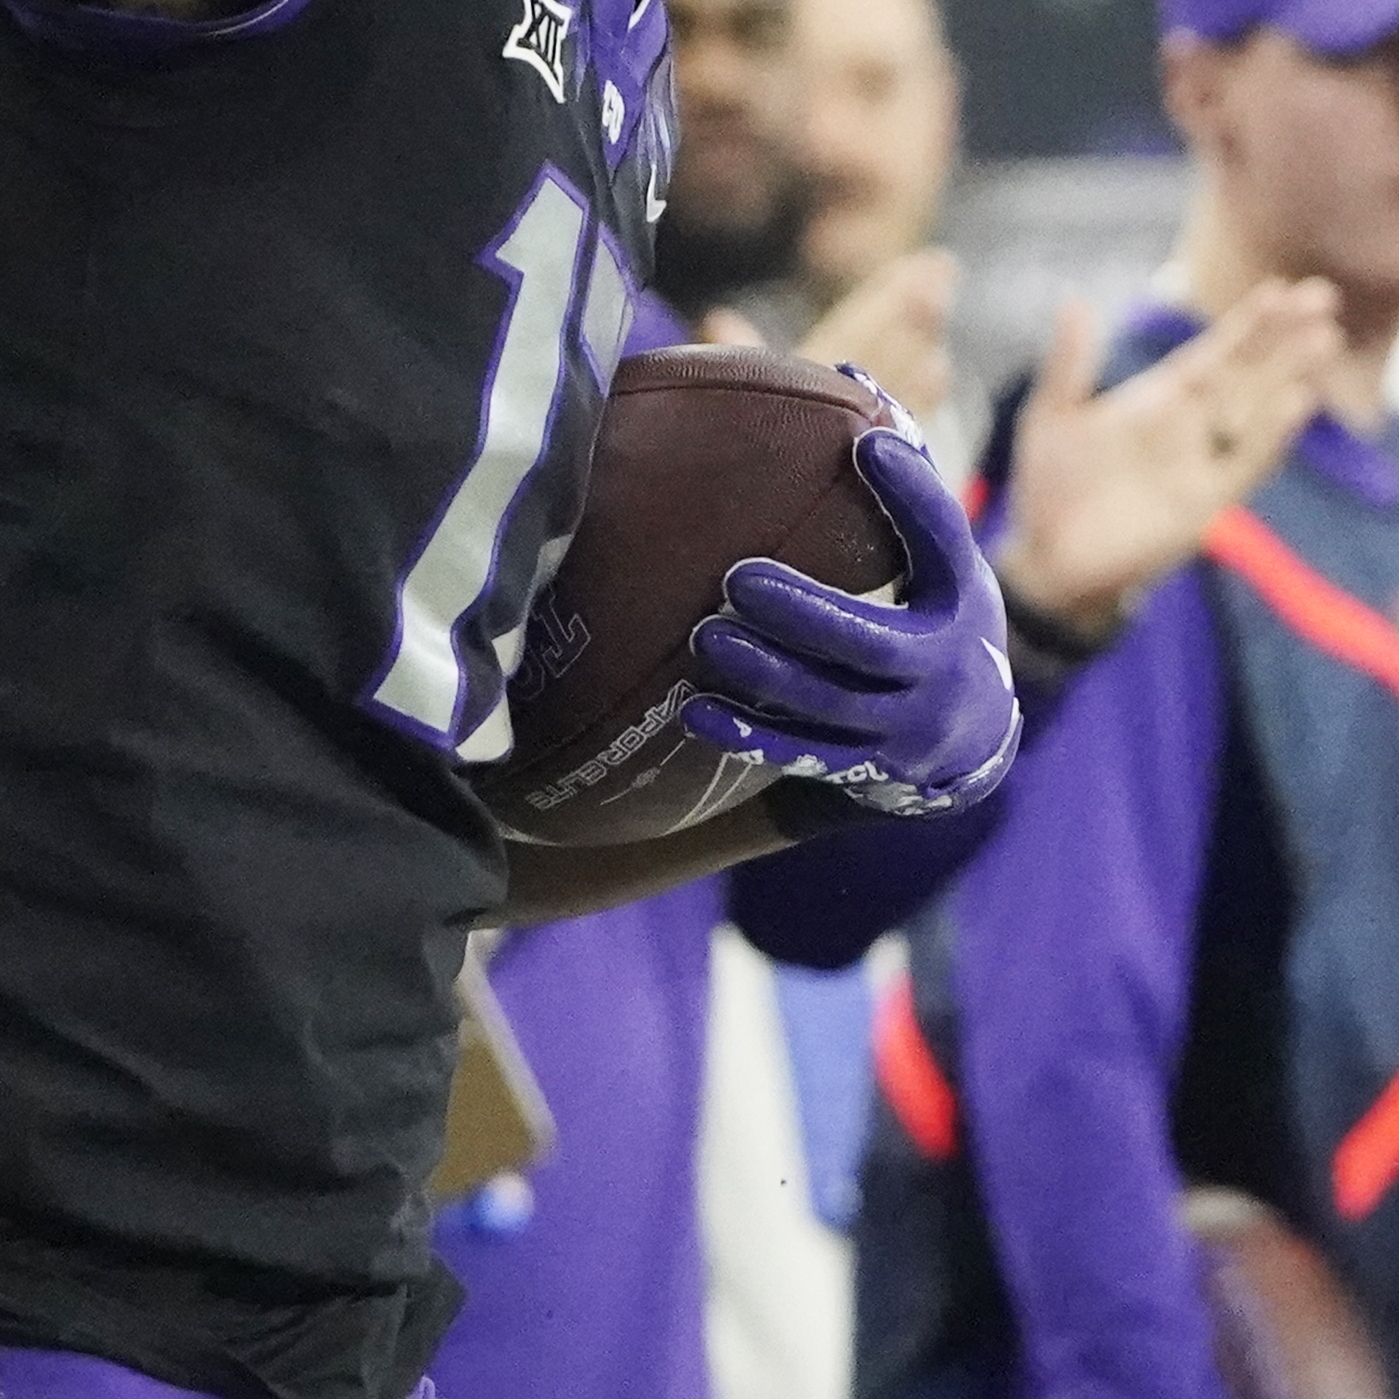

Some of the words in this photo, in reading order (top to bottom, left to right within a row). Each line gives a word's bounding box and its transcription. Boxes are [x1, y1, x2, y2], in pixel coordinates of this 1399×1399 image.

[598, 678, 698, 766] VAPOR
[524, 759, 608, 812] ELITE
[825, 761, 889, 784] TCU
